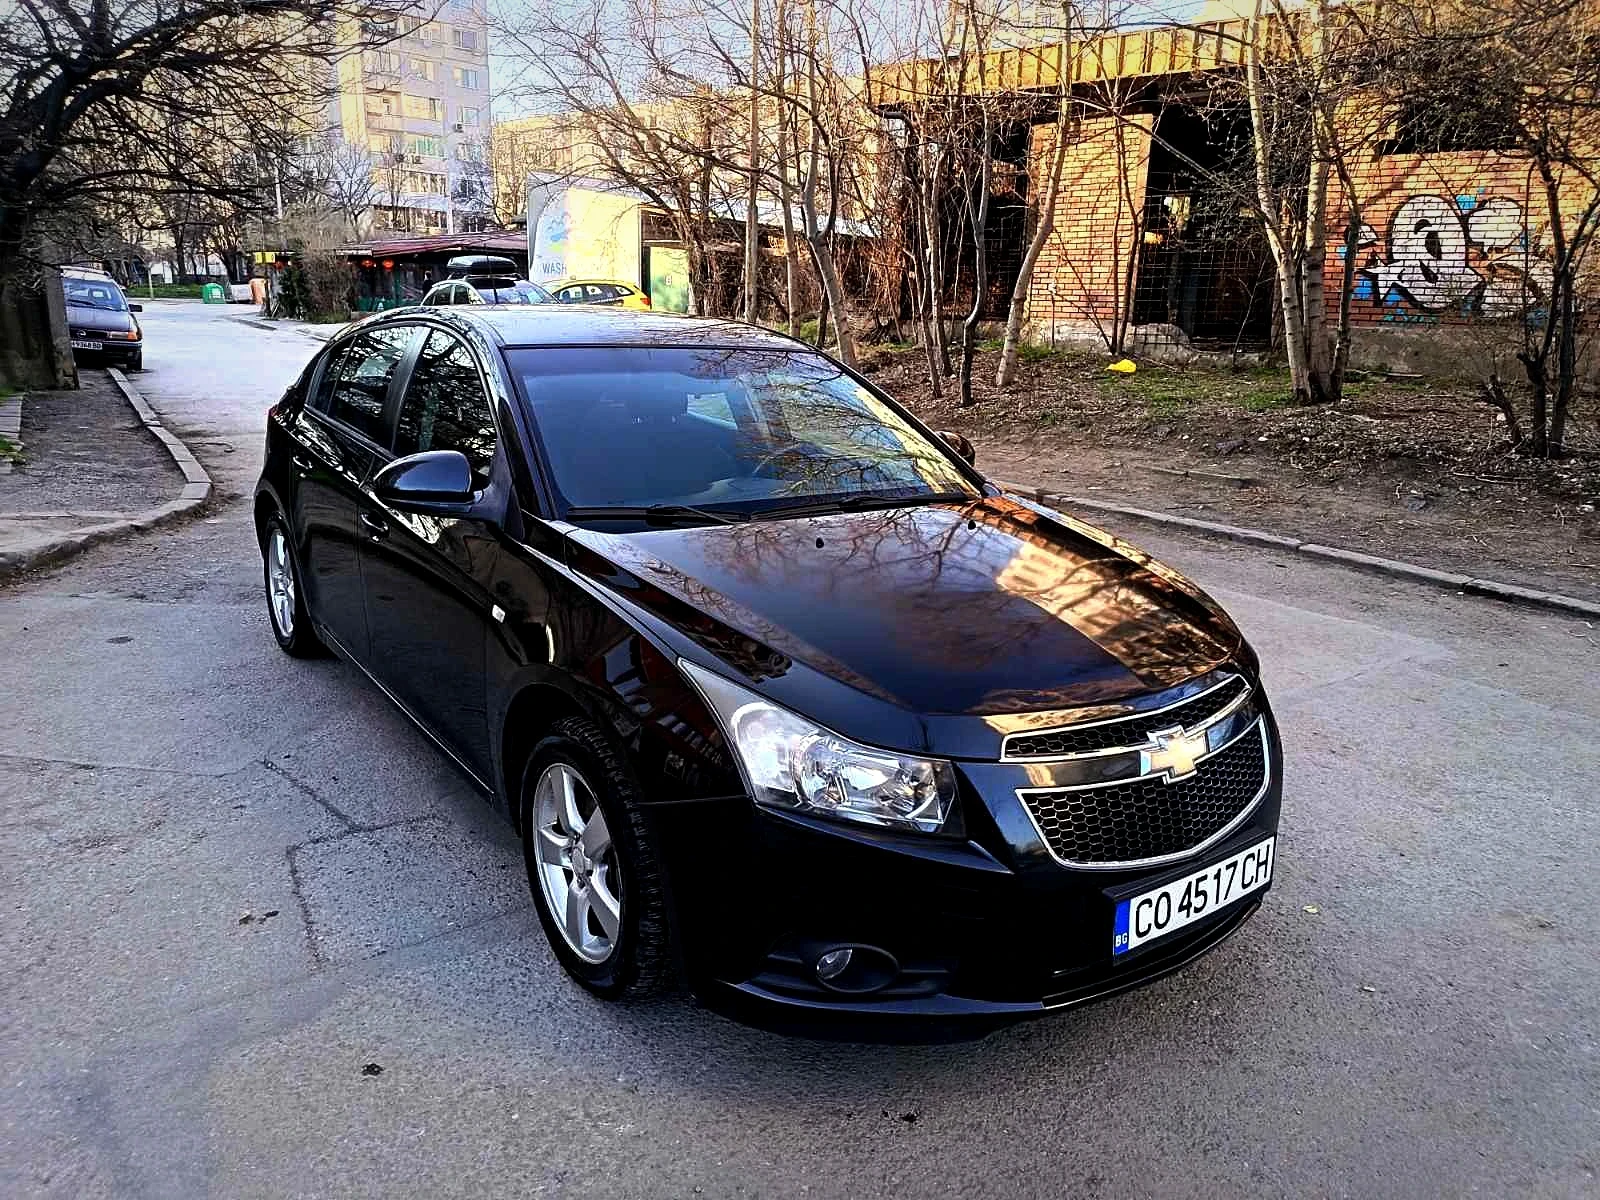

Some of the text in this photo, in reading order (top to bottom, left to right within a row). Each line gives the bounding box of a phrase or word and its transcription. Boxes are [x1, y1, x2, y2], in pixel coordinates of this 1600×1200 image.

[1135, 844, 1271, 938] CO 4517 CH
[1115, 932, 1128, 947] BG
